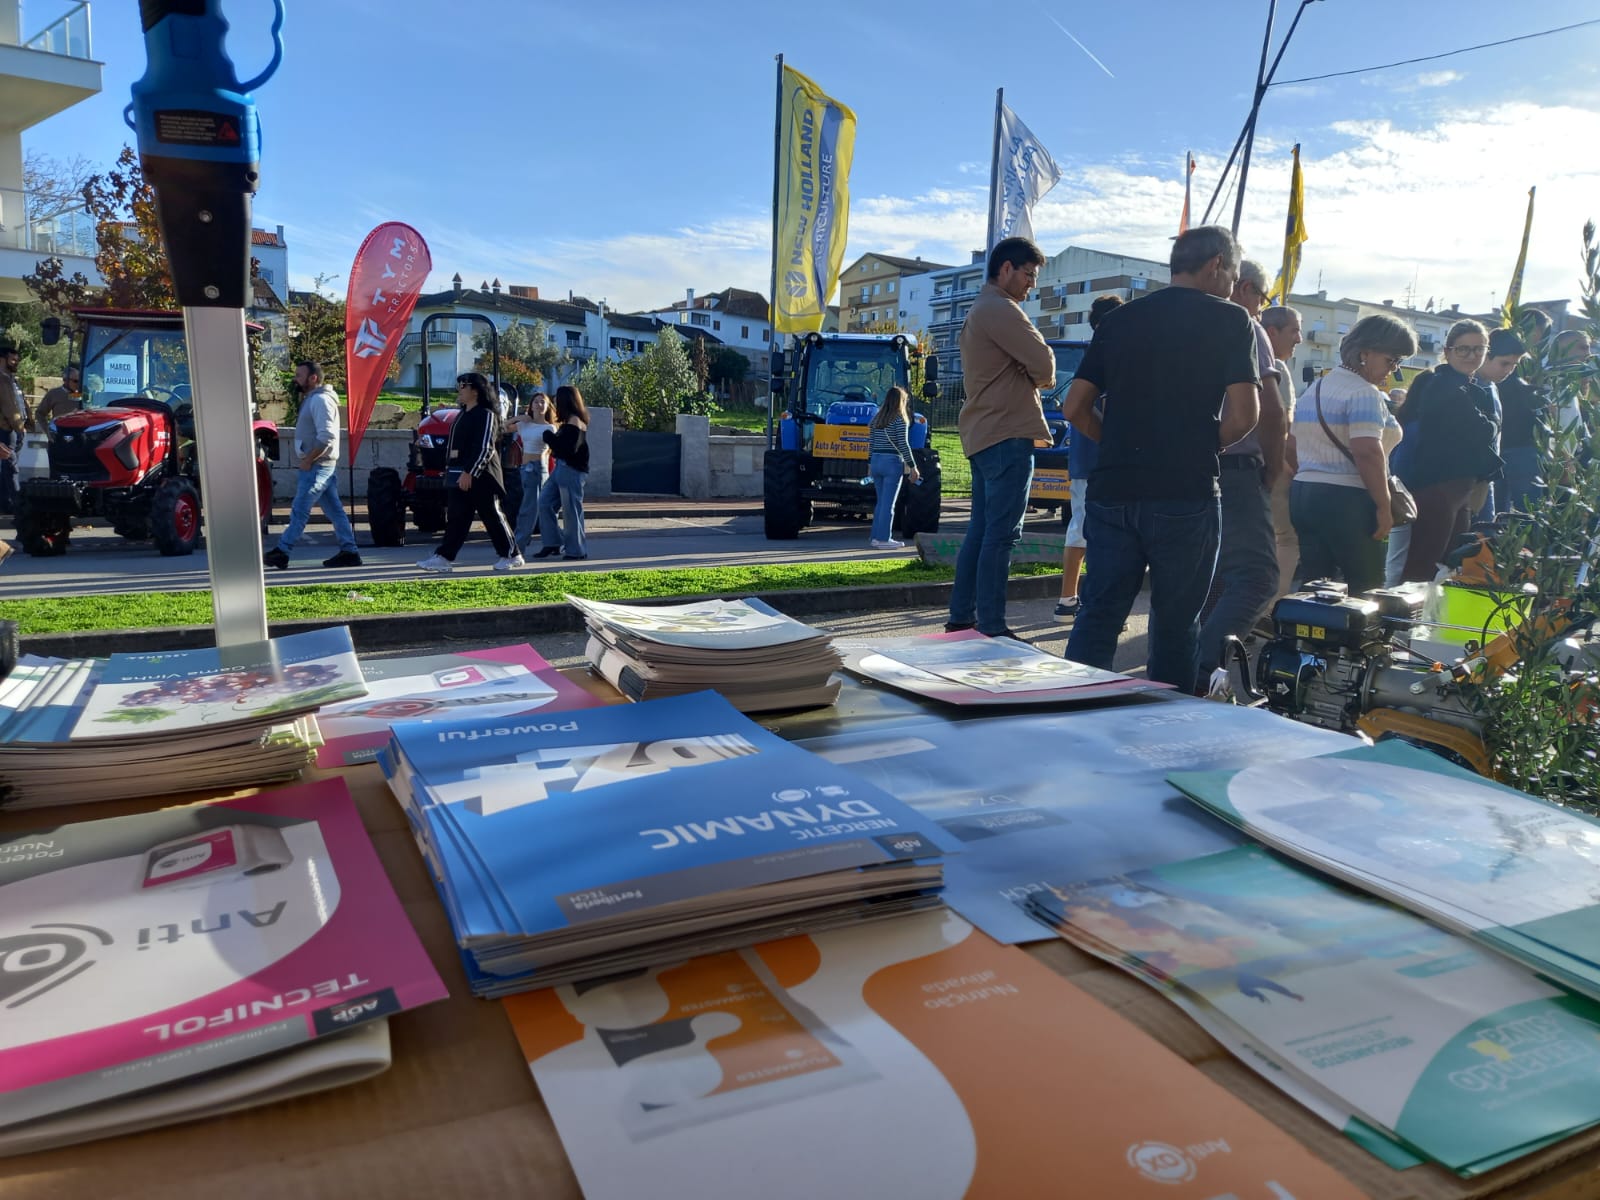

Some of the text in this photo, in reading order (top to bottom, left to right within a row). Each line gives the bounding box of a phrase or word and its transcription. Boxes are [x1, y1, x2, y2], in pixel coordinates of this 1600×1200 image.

[791, 108, 815, 265] NEW HOLLAND
[814, 153, 833, 266] AGRICULTURE
[372, 237, 406, 306] TYM
[388, 246, 418, 313] TRACTORS
[110, 363, 131, 371] MARCO
[121, 672, 182, 681] Vinha
[437, 721, 580, 743] Powerful
[638, 799, 882, 850] DYNAMIC
[787, 817, 898, 841] NERGETIC
[893, 838, 922, 852] ADP
[569, 888, 606, 904] TECH
[573, 889, 643, 911] Fertiberia
[136, 900, 288, 952] Anti
[921, 971, 997, 993] ativada
[144, 973, 369, 1041] TECNIFOL
[921, 985, 1020, 1010] Nutrição
[332, 999, 379, 1023] ADP
[735, 1055, 830, 1083] PLUSMASTER
